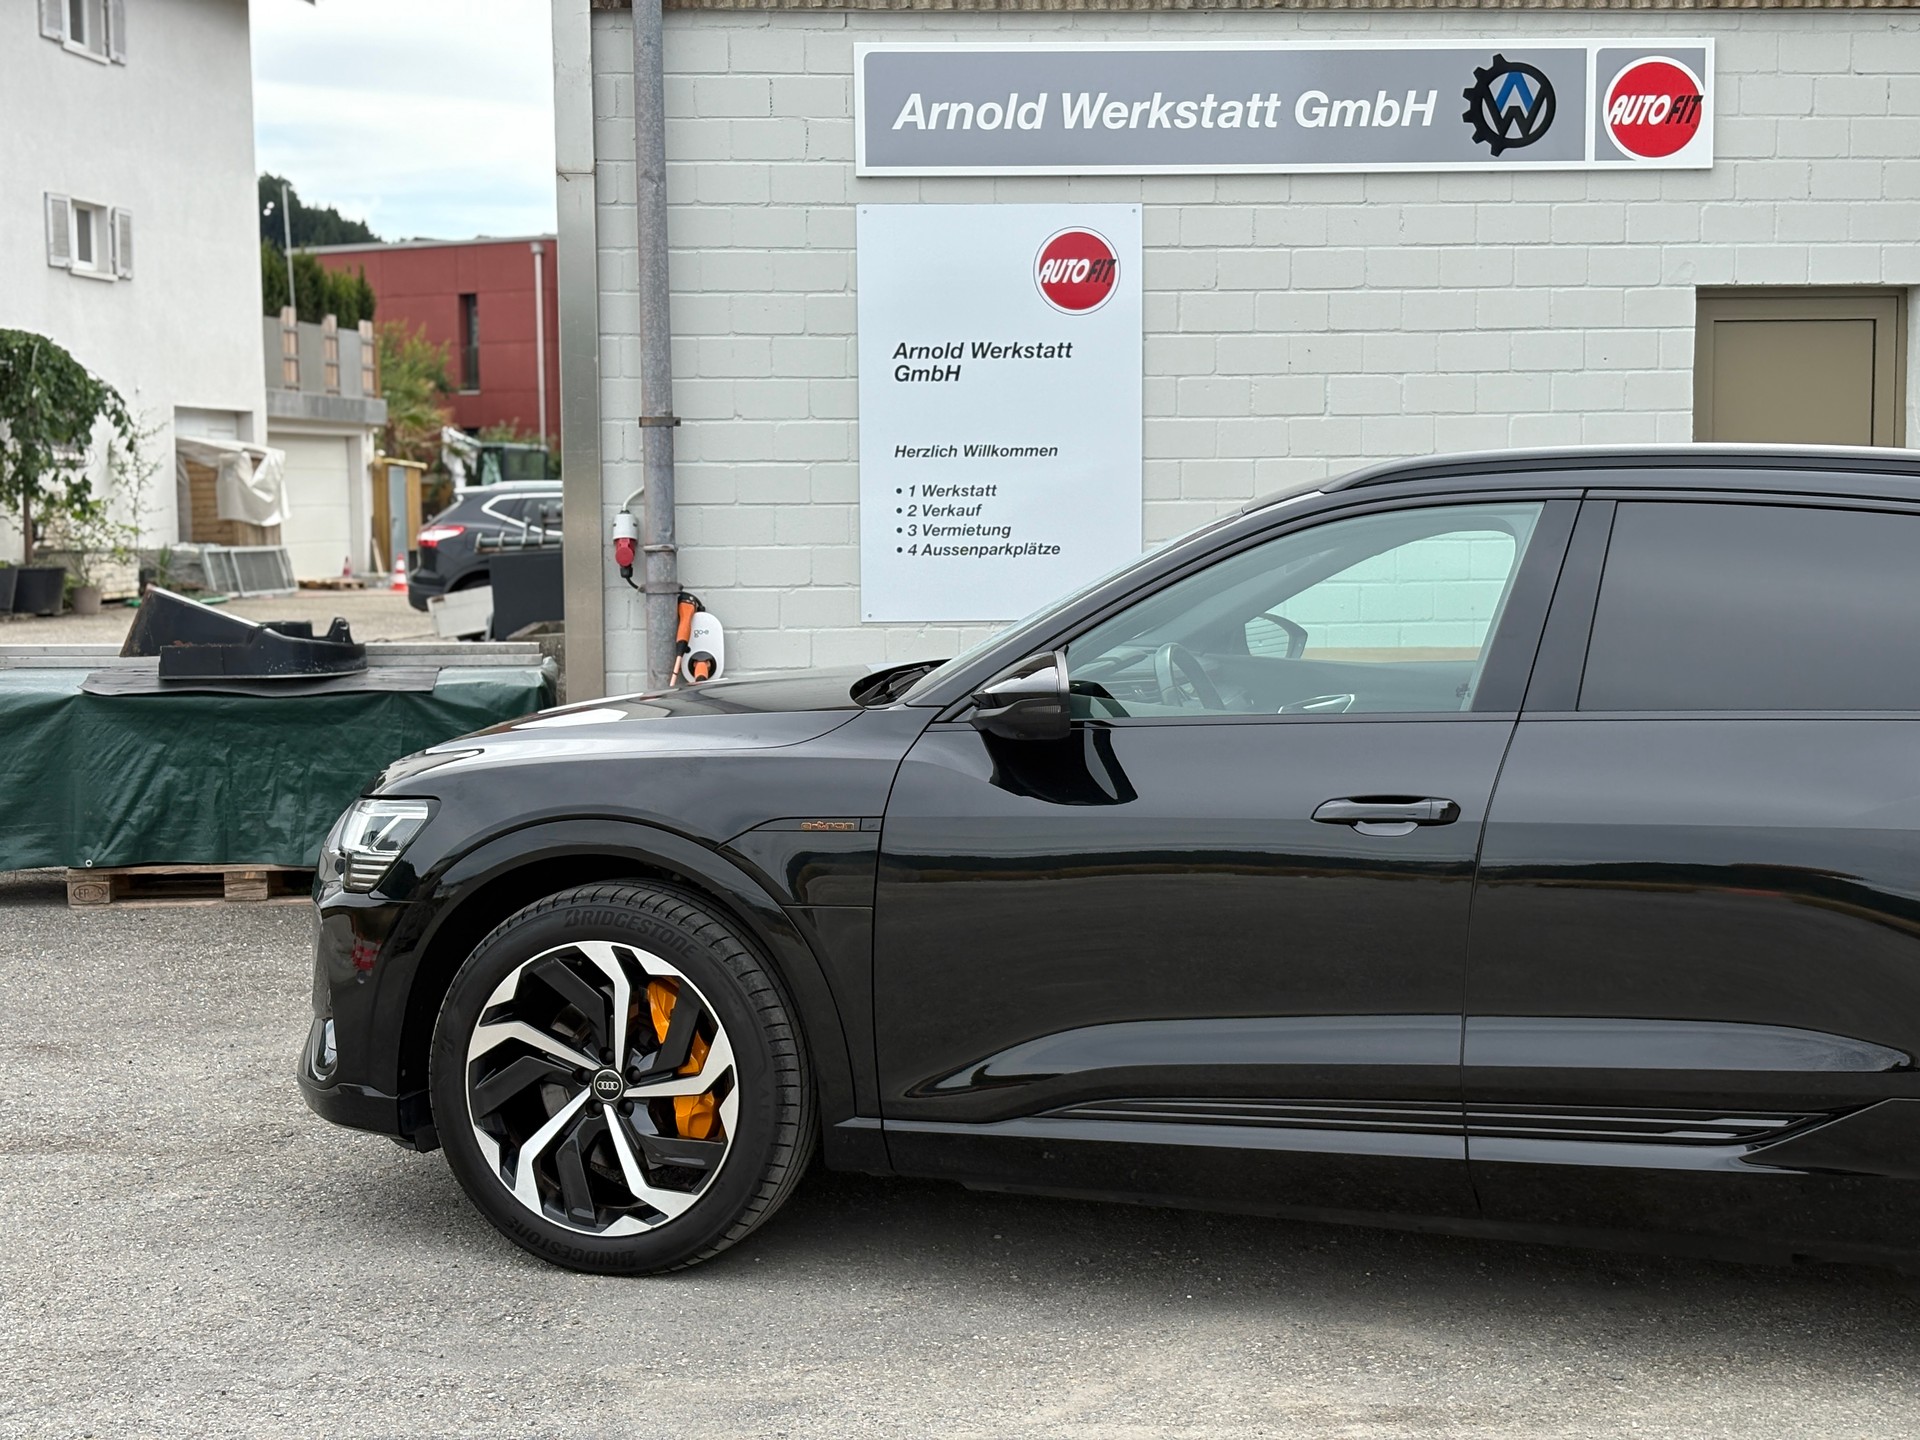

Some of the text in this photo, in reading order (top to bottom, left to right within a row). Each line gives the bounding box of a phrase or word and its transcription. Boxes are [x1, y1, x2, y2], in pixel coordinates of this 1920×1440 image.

[892, 90, 1438, 130] Arnold Werkstatt GmbH
[1609, 94, 1704, 126] AUTOFIT
[1040, 258, 1117, 284] AUTOFIT
[892, 341, 1073, 359] Arnold Werkstatt
[894, 365, 961, 382] GmbH
[894, 444, 1058, 458] Herzlich Willkommen
[908, 484, 997, 497] 1 Werkstatt
[907, 503, 983, 517] 2 Verkauf
[907, 523, 1012, 539] 3 Vermietung
[907, 542, 1061, 558] 4 Aussenparkplätze
[564, 908, 699, 959] BRIDGESTONE
